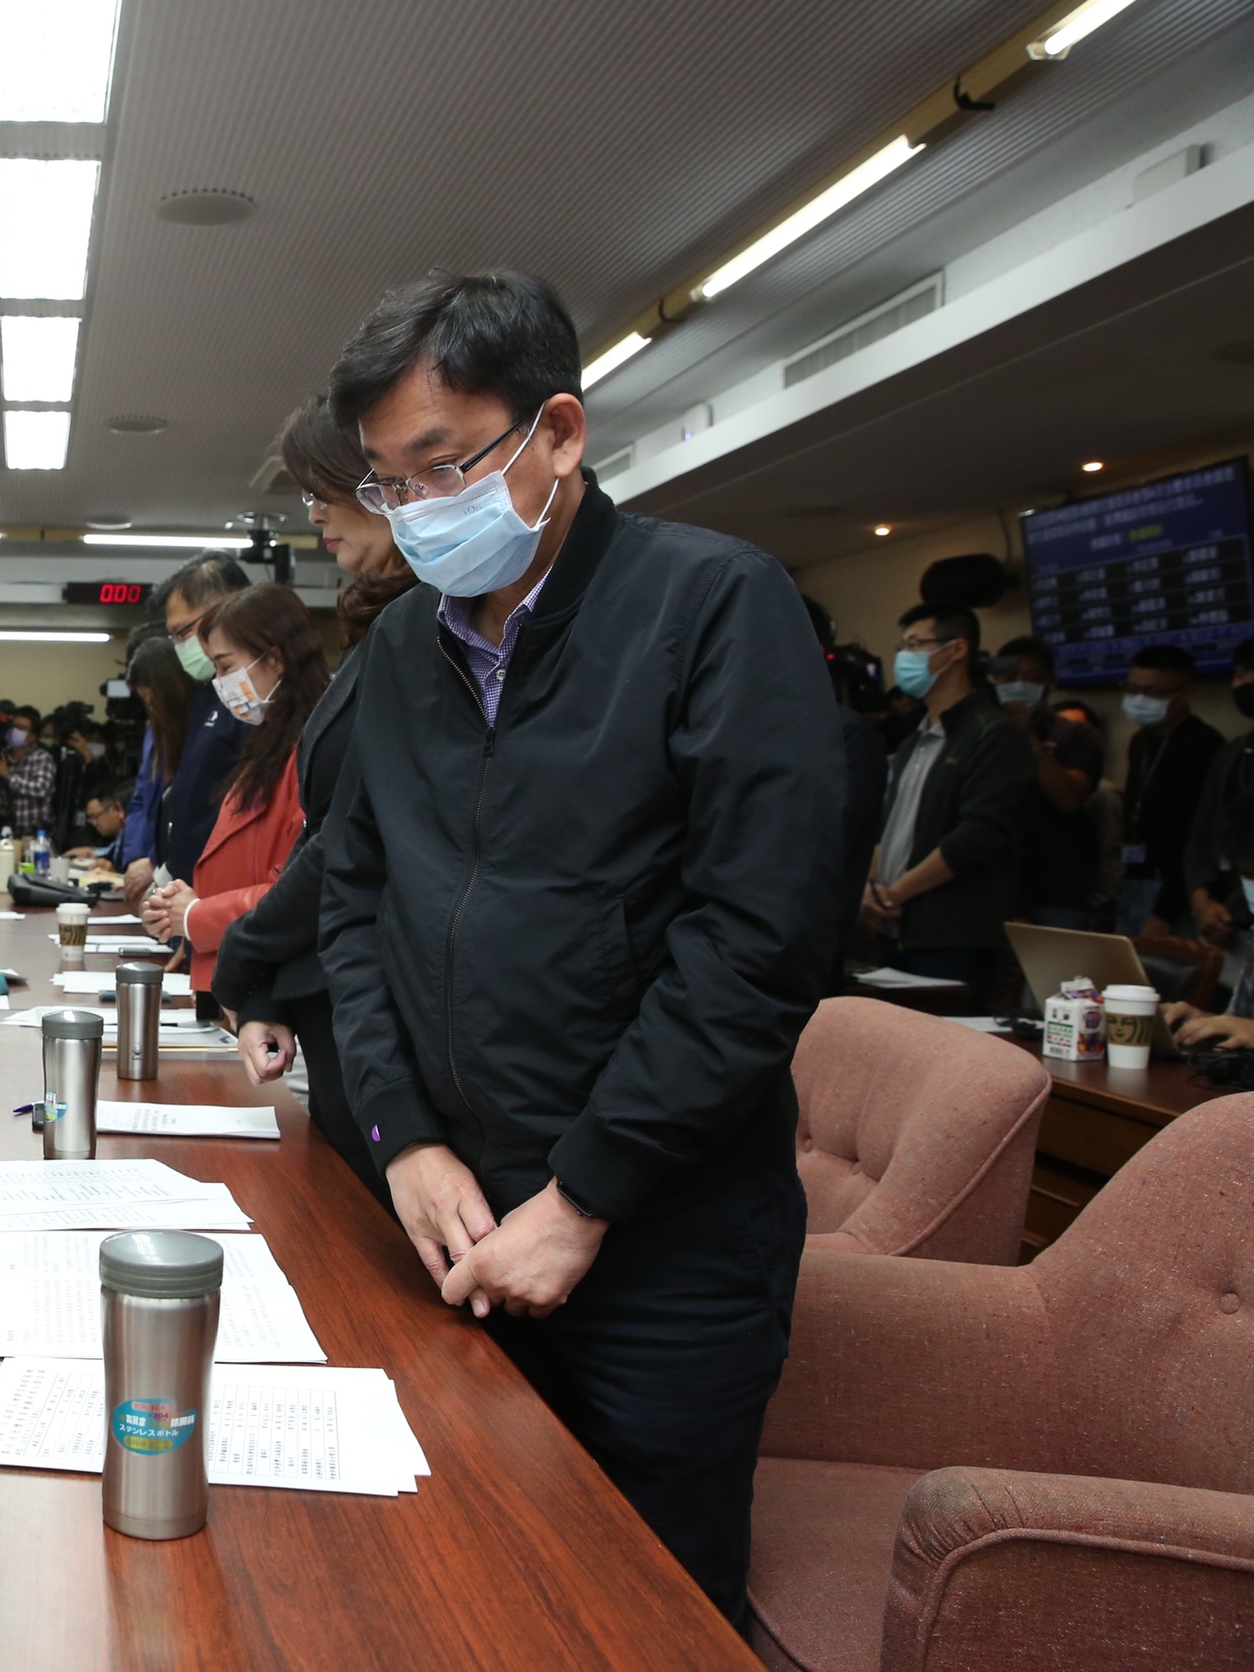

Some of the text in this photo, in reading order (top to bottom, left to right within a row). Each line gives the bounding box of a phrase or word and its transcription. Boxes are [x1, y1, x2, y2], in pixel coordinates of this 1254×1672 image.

[119, 1425, 179, 1437] ステンレスボトル
